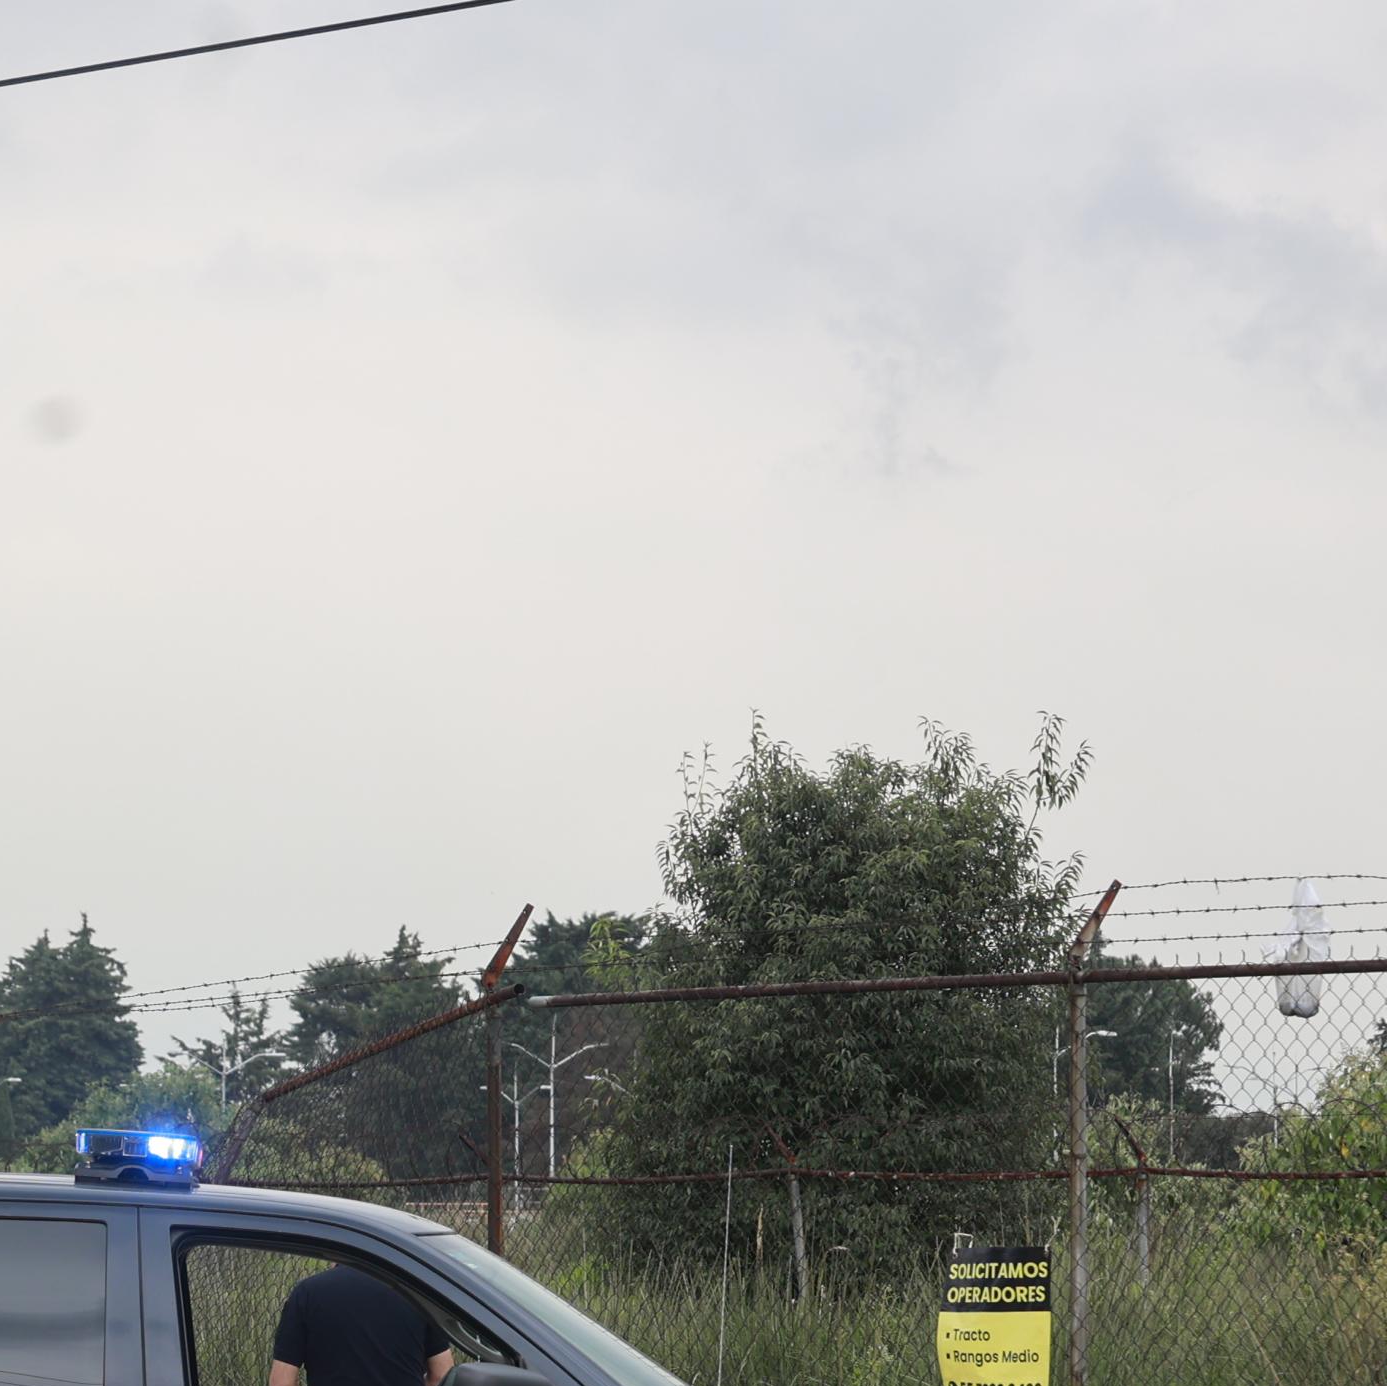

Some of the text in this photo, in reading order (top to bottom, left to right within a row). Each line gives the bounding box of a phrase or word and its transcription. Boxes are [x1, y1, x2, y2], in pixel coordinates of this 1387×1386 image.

[949, 1261, 1048, 1280] SOLICITAMOS
[947, 1286, 1046, 1303] OPERADORES
[953, 1329, 990, 1341] Tracto
[953, 1350, 1039, 1367] Rangos Medio
